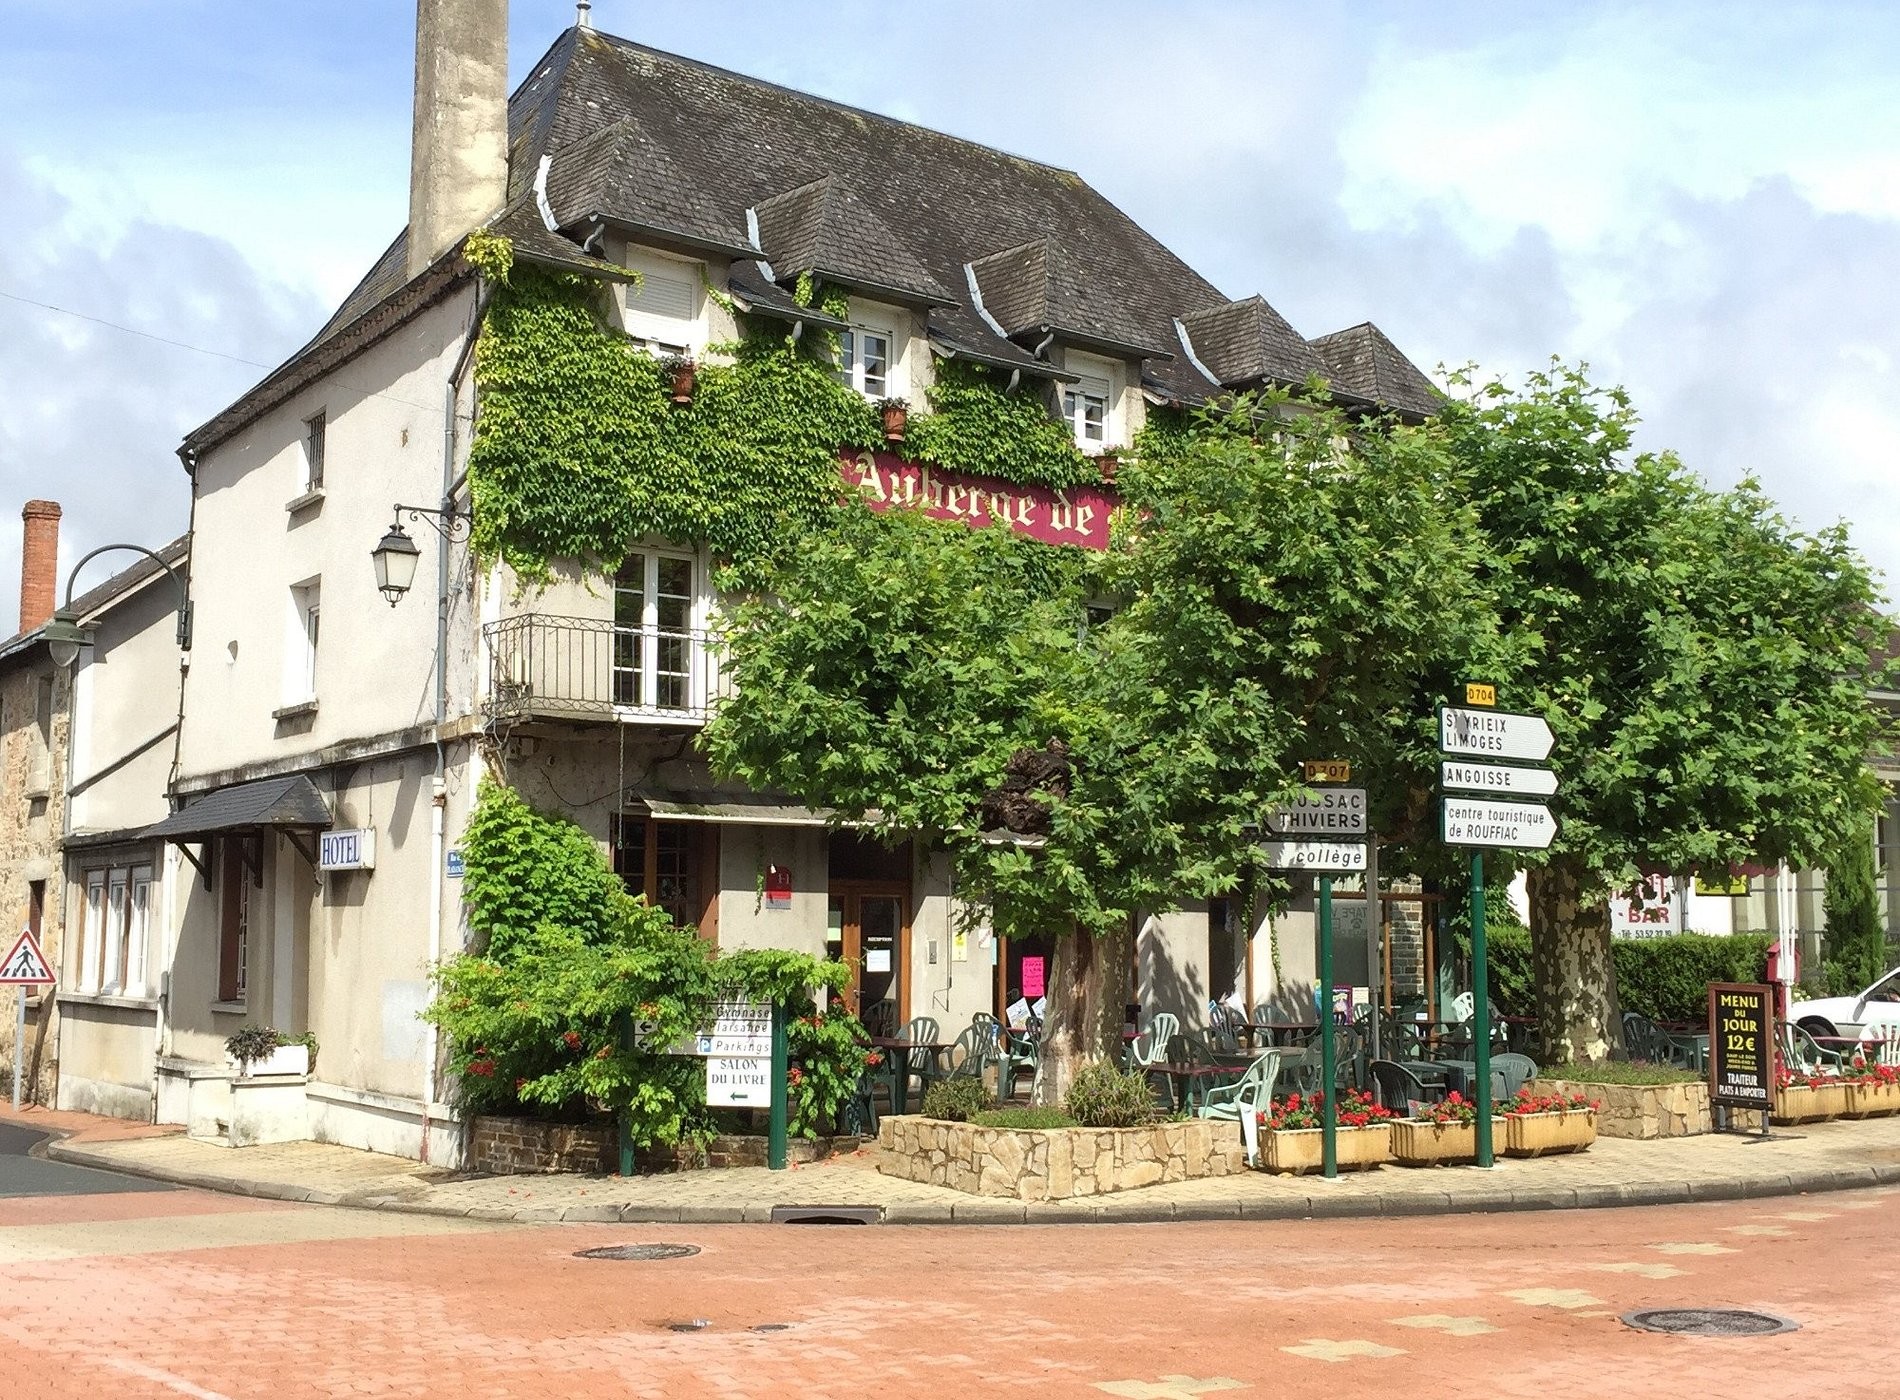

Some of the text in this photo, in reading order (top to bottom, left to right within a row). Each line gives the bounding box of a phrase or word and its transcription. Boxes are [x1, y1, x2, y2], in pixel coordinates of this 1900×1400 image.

[1049, 489, 1095, 536] de
[1464, 716, 1506, 733] YRIEIX
[1446, 732, 1502, 750] LIMOGES
[1447, 768, 1511, 786] ANGOISSE
[1297, 793, 1360, 808] USAC
[1280, 813, 1361, 828] THIVIERS
[1448, 808, 1545, 826] centre touristique
[1449, 823, 1519, 840] de ROUFFIAC
[322, 835, 360, 865] HOTEL
[1296, 849, 1362, 867] collège
[1628, 906, 1669, 923] BAR
[1720, 994, 1758, 1008] MENU
[717, 1006, 769, 1019] Gymnase
[1734, 1009, 1746, 1018] DU
[714, 1022, 768, 1033] laisance
[1723, 1018, 1758, 1032] JOUR
[716, 1040, 769, 1055] Parkings
[720, 1059, 759, 1070] SALON
[711, 1074, 767, 1085] DU LIVRE
[1727, 1072, 1758, 1086] TRAITEUR
[1719, 1084, 1766, 1099] PLATS A EMPORTER
